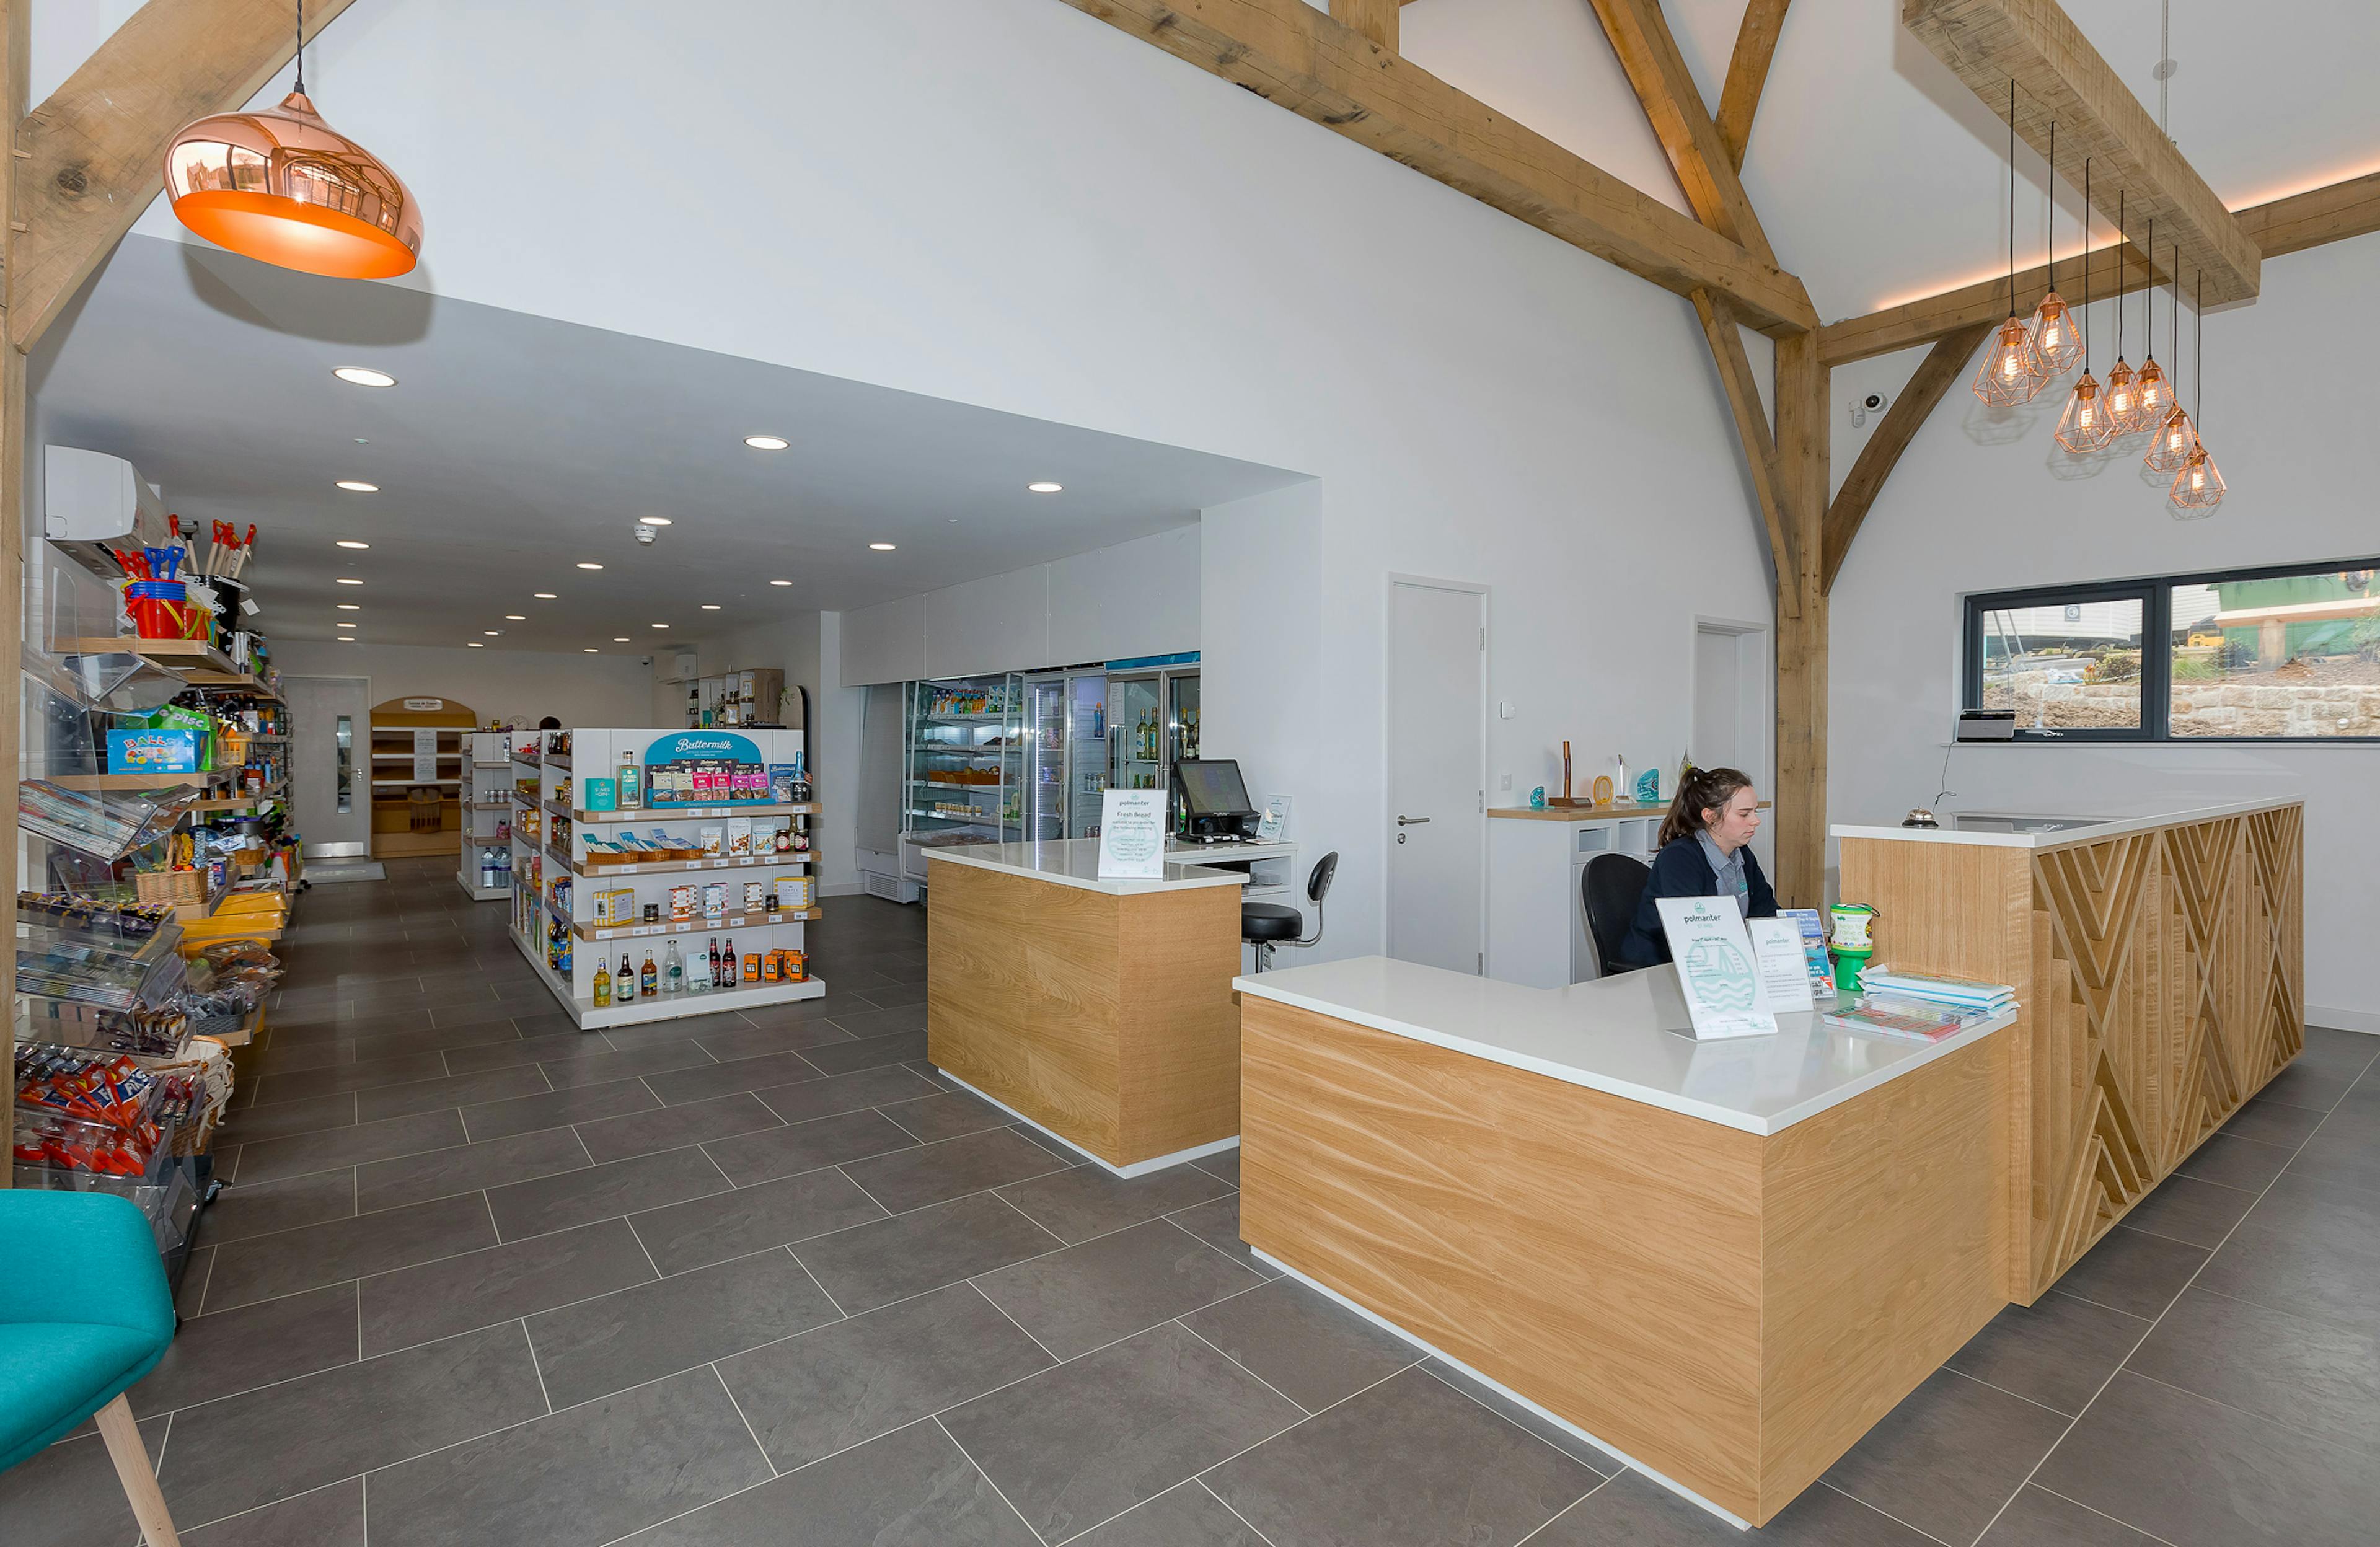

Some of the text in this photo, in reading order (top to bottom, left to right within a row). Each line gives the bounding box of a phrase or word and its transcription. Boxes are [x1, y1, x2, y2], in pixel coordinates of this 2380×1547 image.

[172, 712, 205, 728] DISC
[124, 735, 175, 750] BALLS
[676, 738, 733, 753] Buttermilk
[1684, 914, 1721, 924] polmanter
